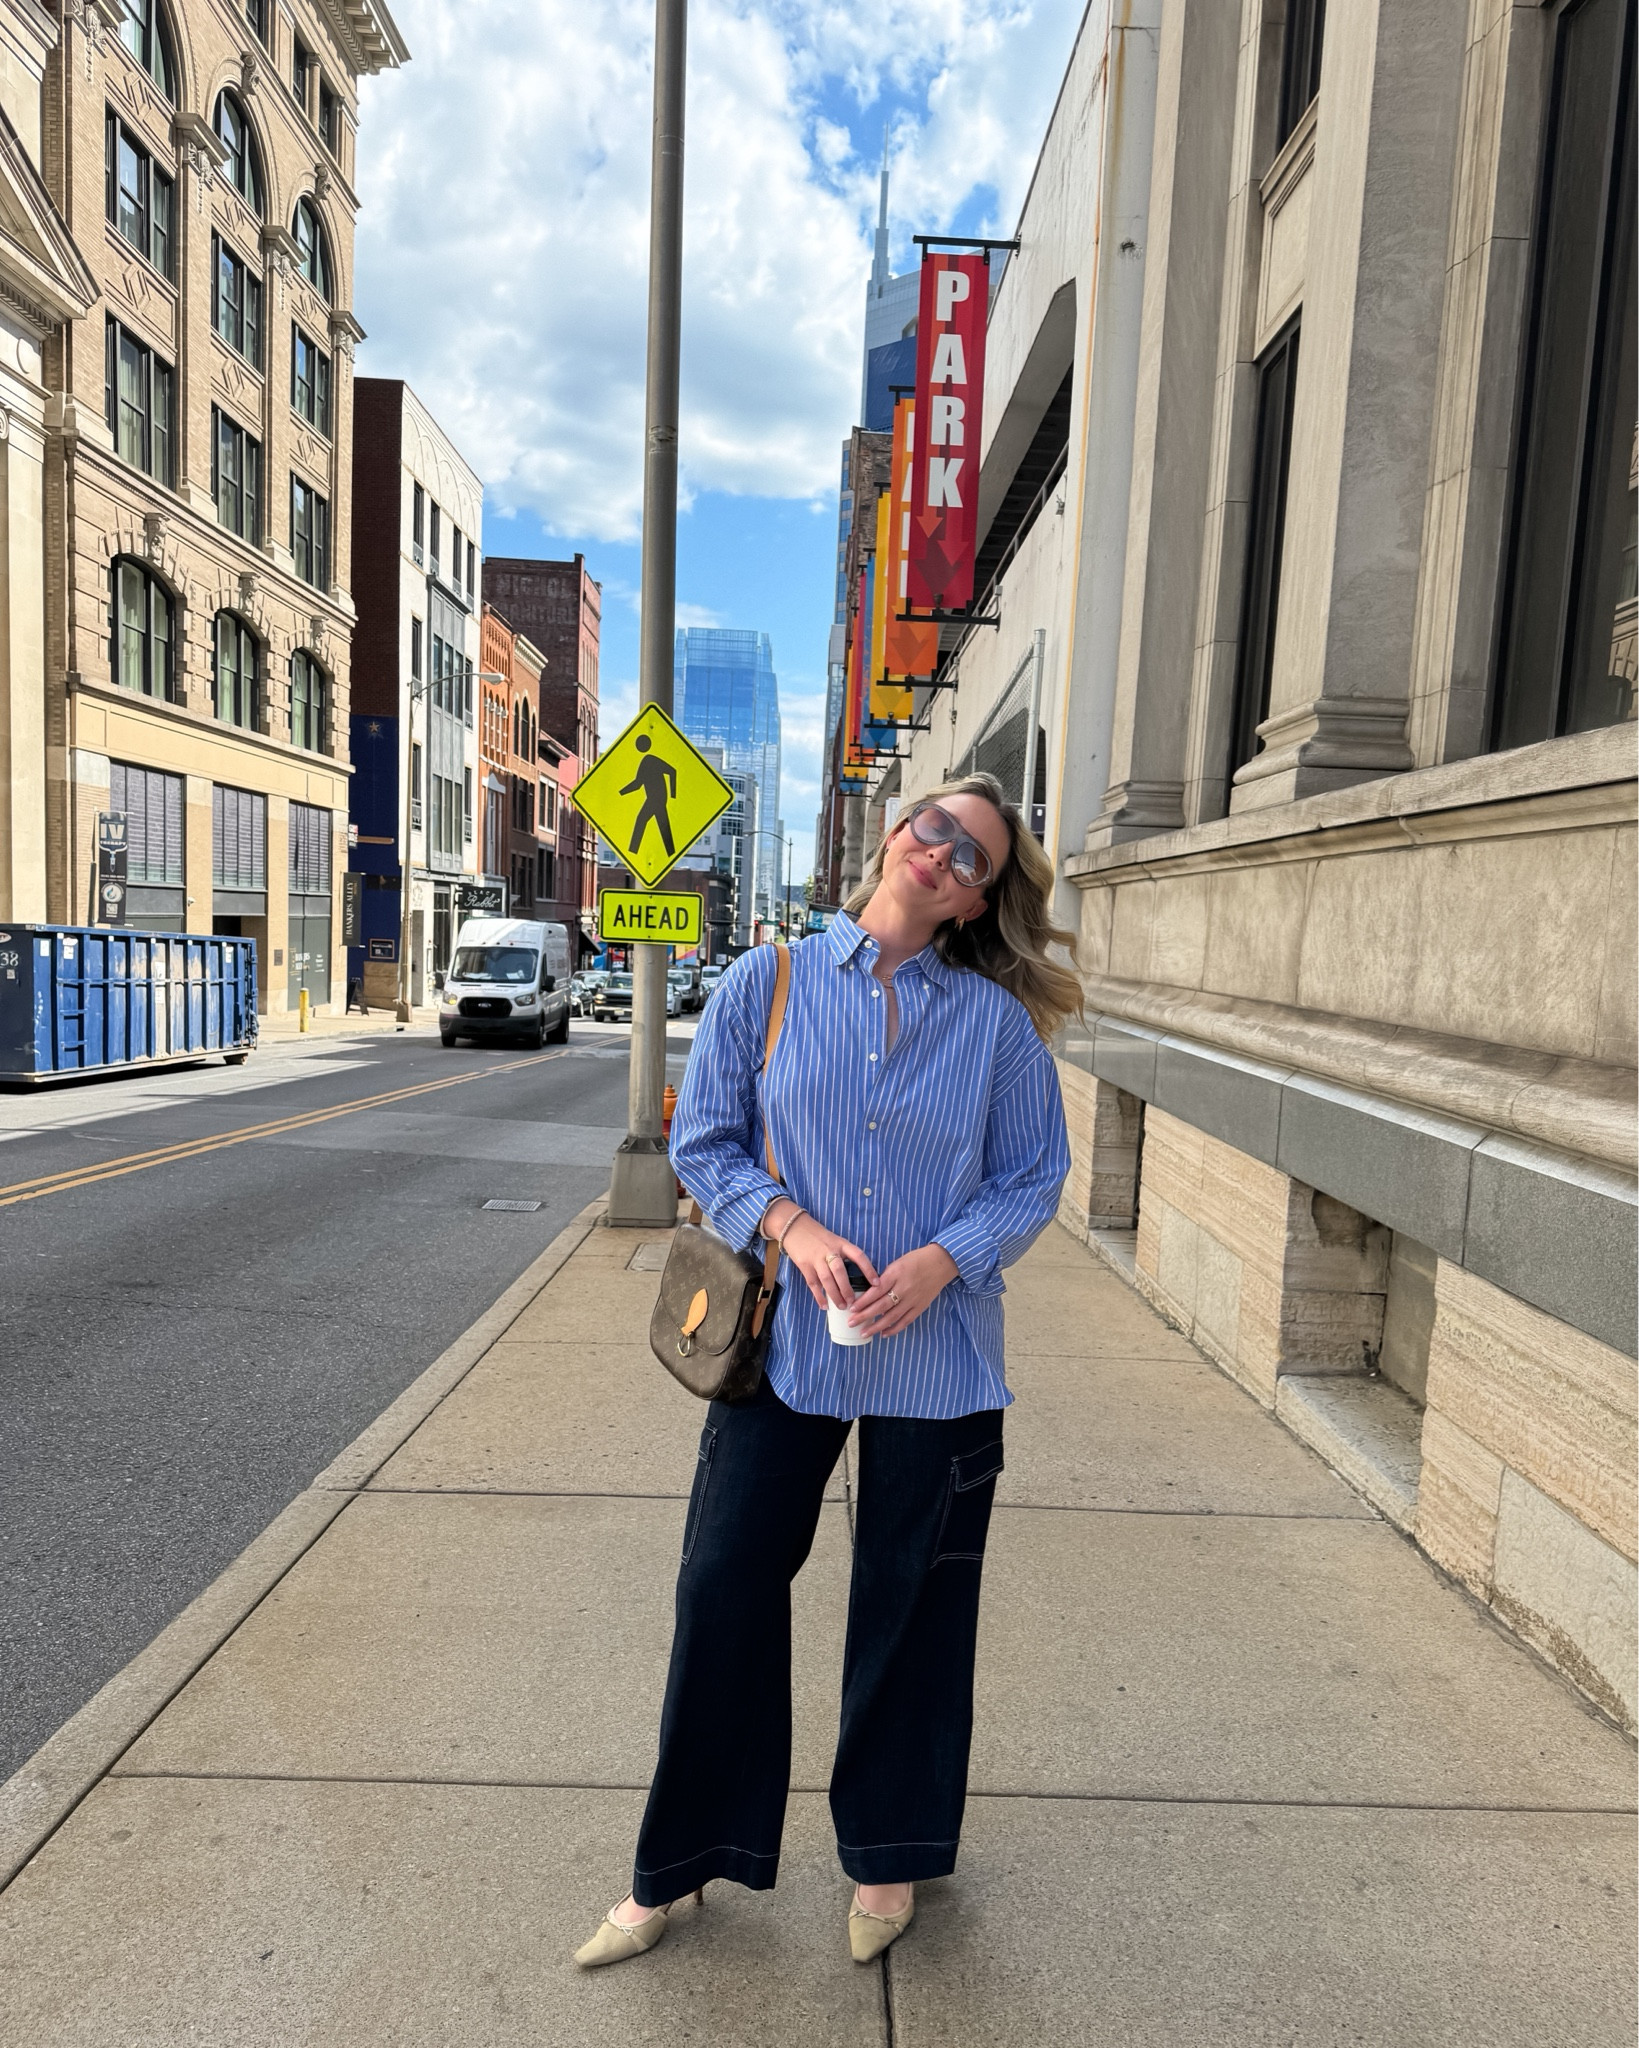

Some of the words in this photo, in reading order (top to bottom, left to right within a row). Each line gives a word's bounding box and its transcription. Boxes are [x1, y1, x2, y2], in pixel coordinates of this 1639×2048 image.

[928, 270, 970, 508] PARK
[100, 823, 125, 839] IV
[346, 882, 354, 901] ALLEY
[346, 902, 354, 935] BANKERS
[613, 904, 689, 930] AHEAD
[0, 951, 19, 967] 38
